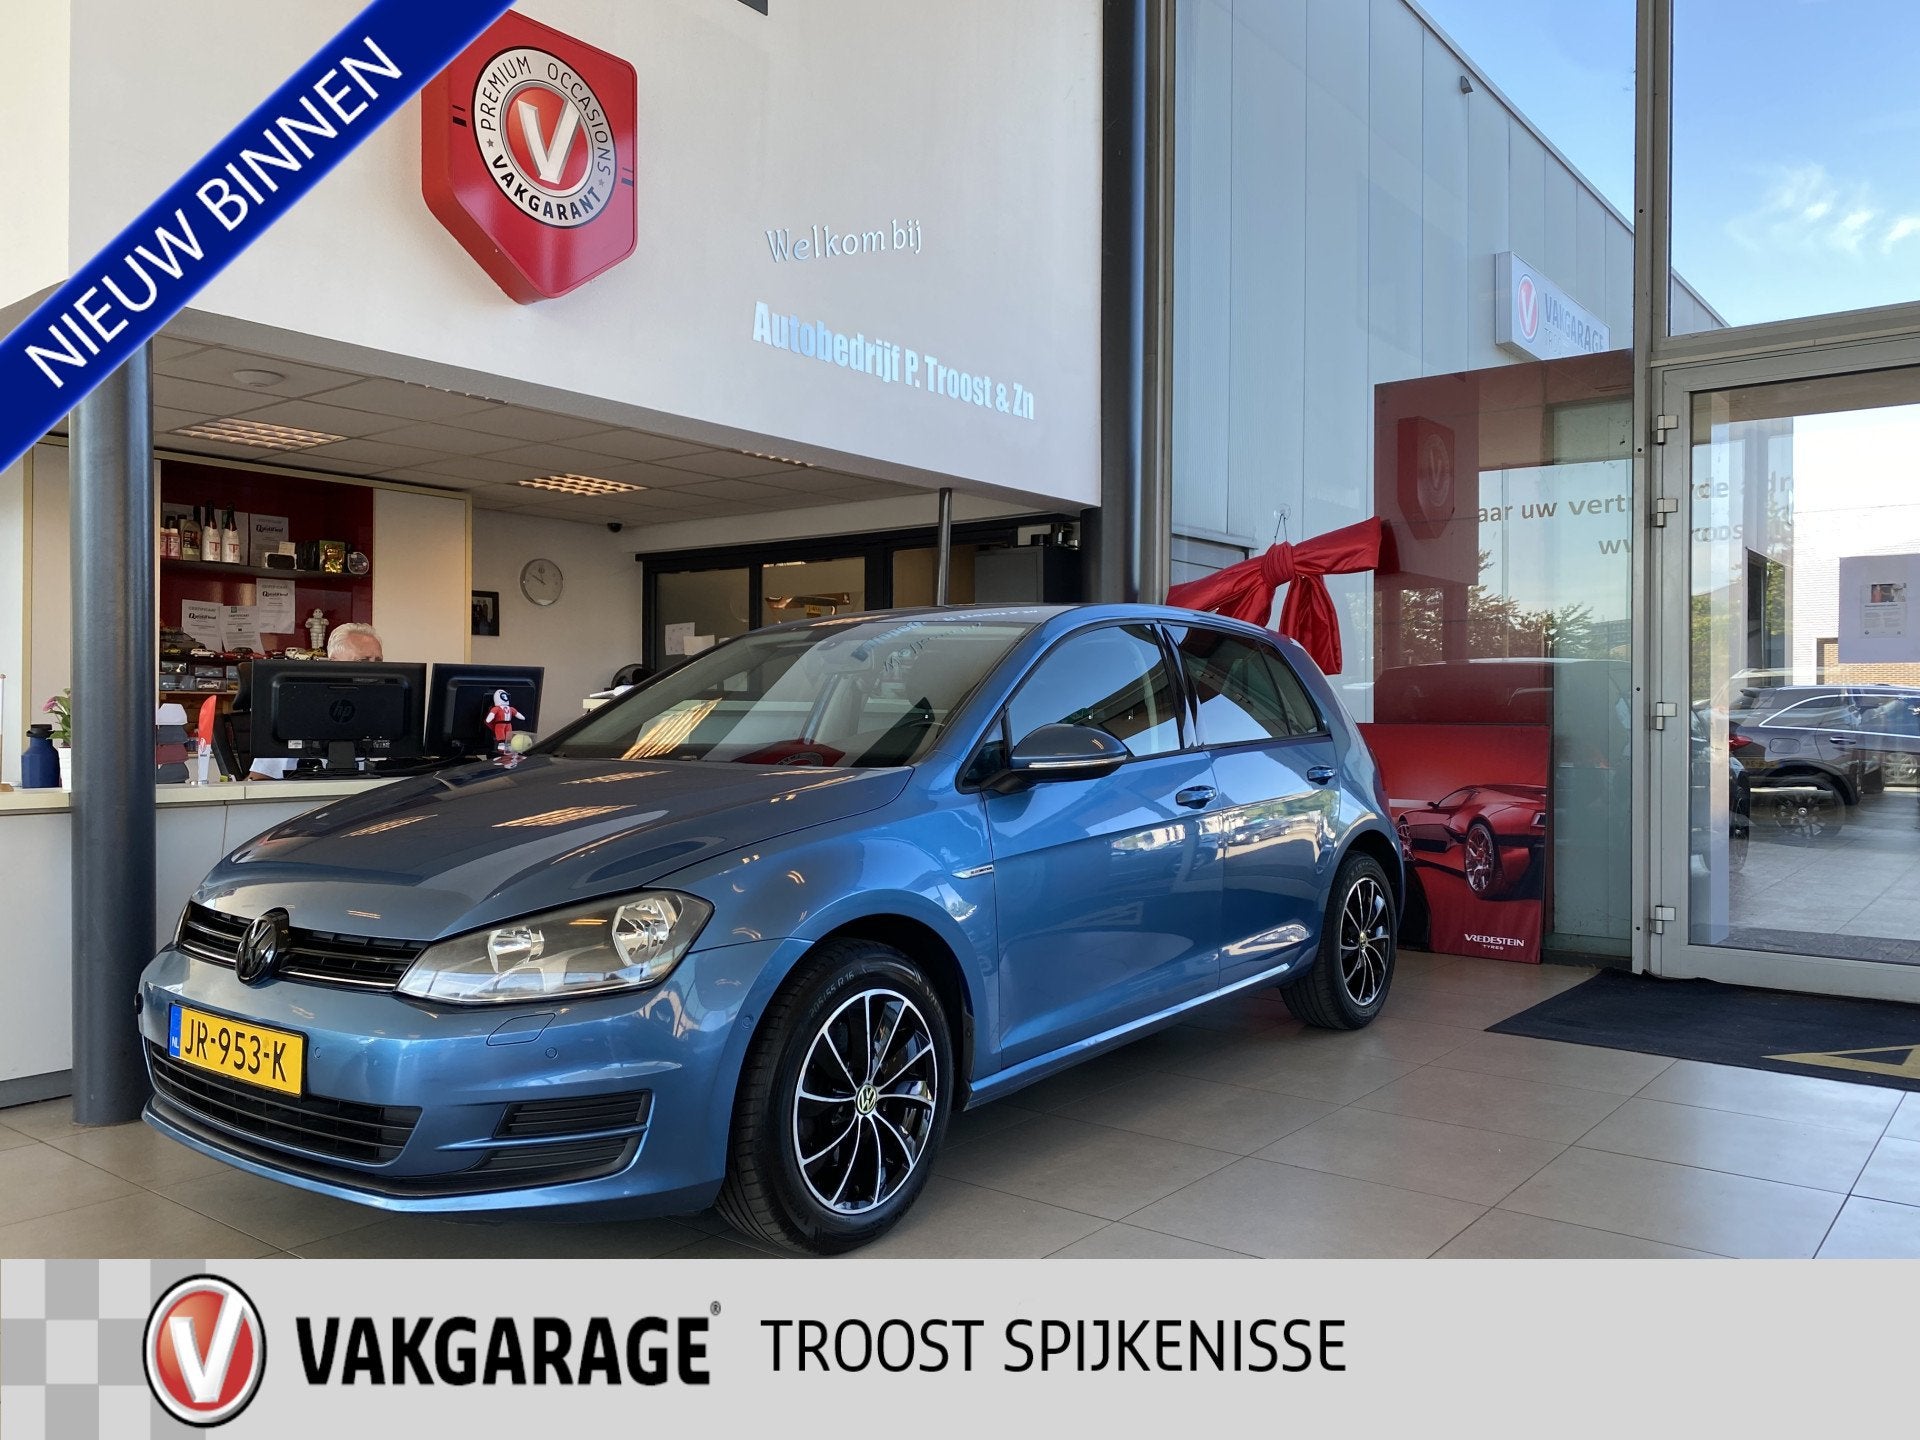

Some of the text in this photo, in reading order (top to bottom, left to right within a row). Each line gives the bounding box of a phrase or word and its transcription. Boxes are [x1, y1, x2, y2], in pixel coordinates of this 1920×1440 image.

[480, 56, 611, 177] PREMIUM OCCASIONS
[492, 154, 601, 221] VAKGARANT
[766, 218, 922, 263] Welkom bij
[752, 300, 1034, 420] Autobedrijf P. Troost & Zn
[1521, 501, 1558, 519] uw
[1464, 933, 1525, 947] VREDESTEIN
[171, 1018, 287, 1083] NL JR-953-K
